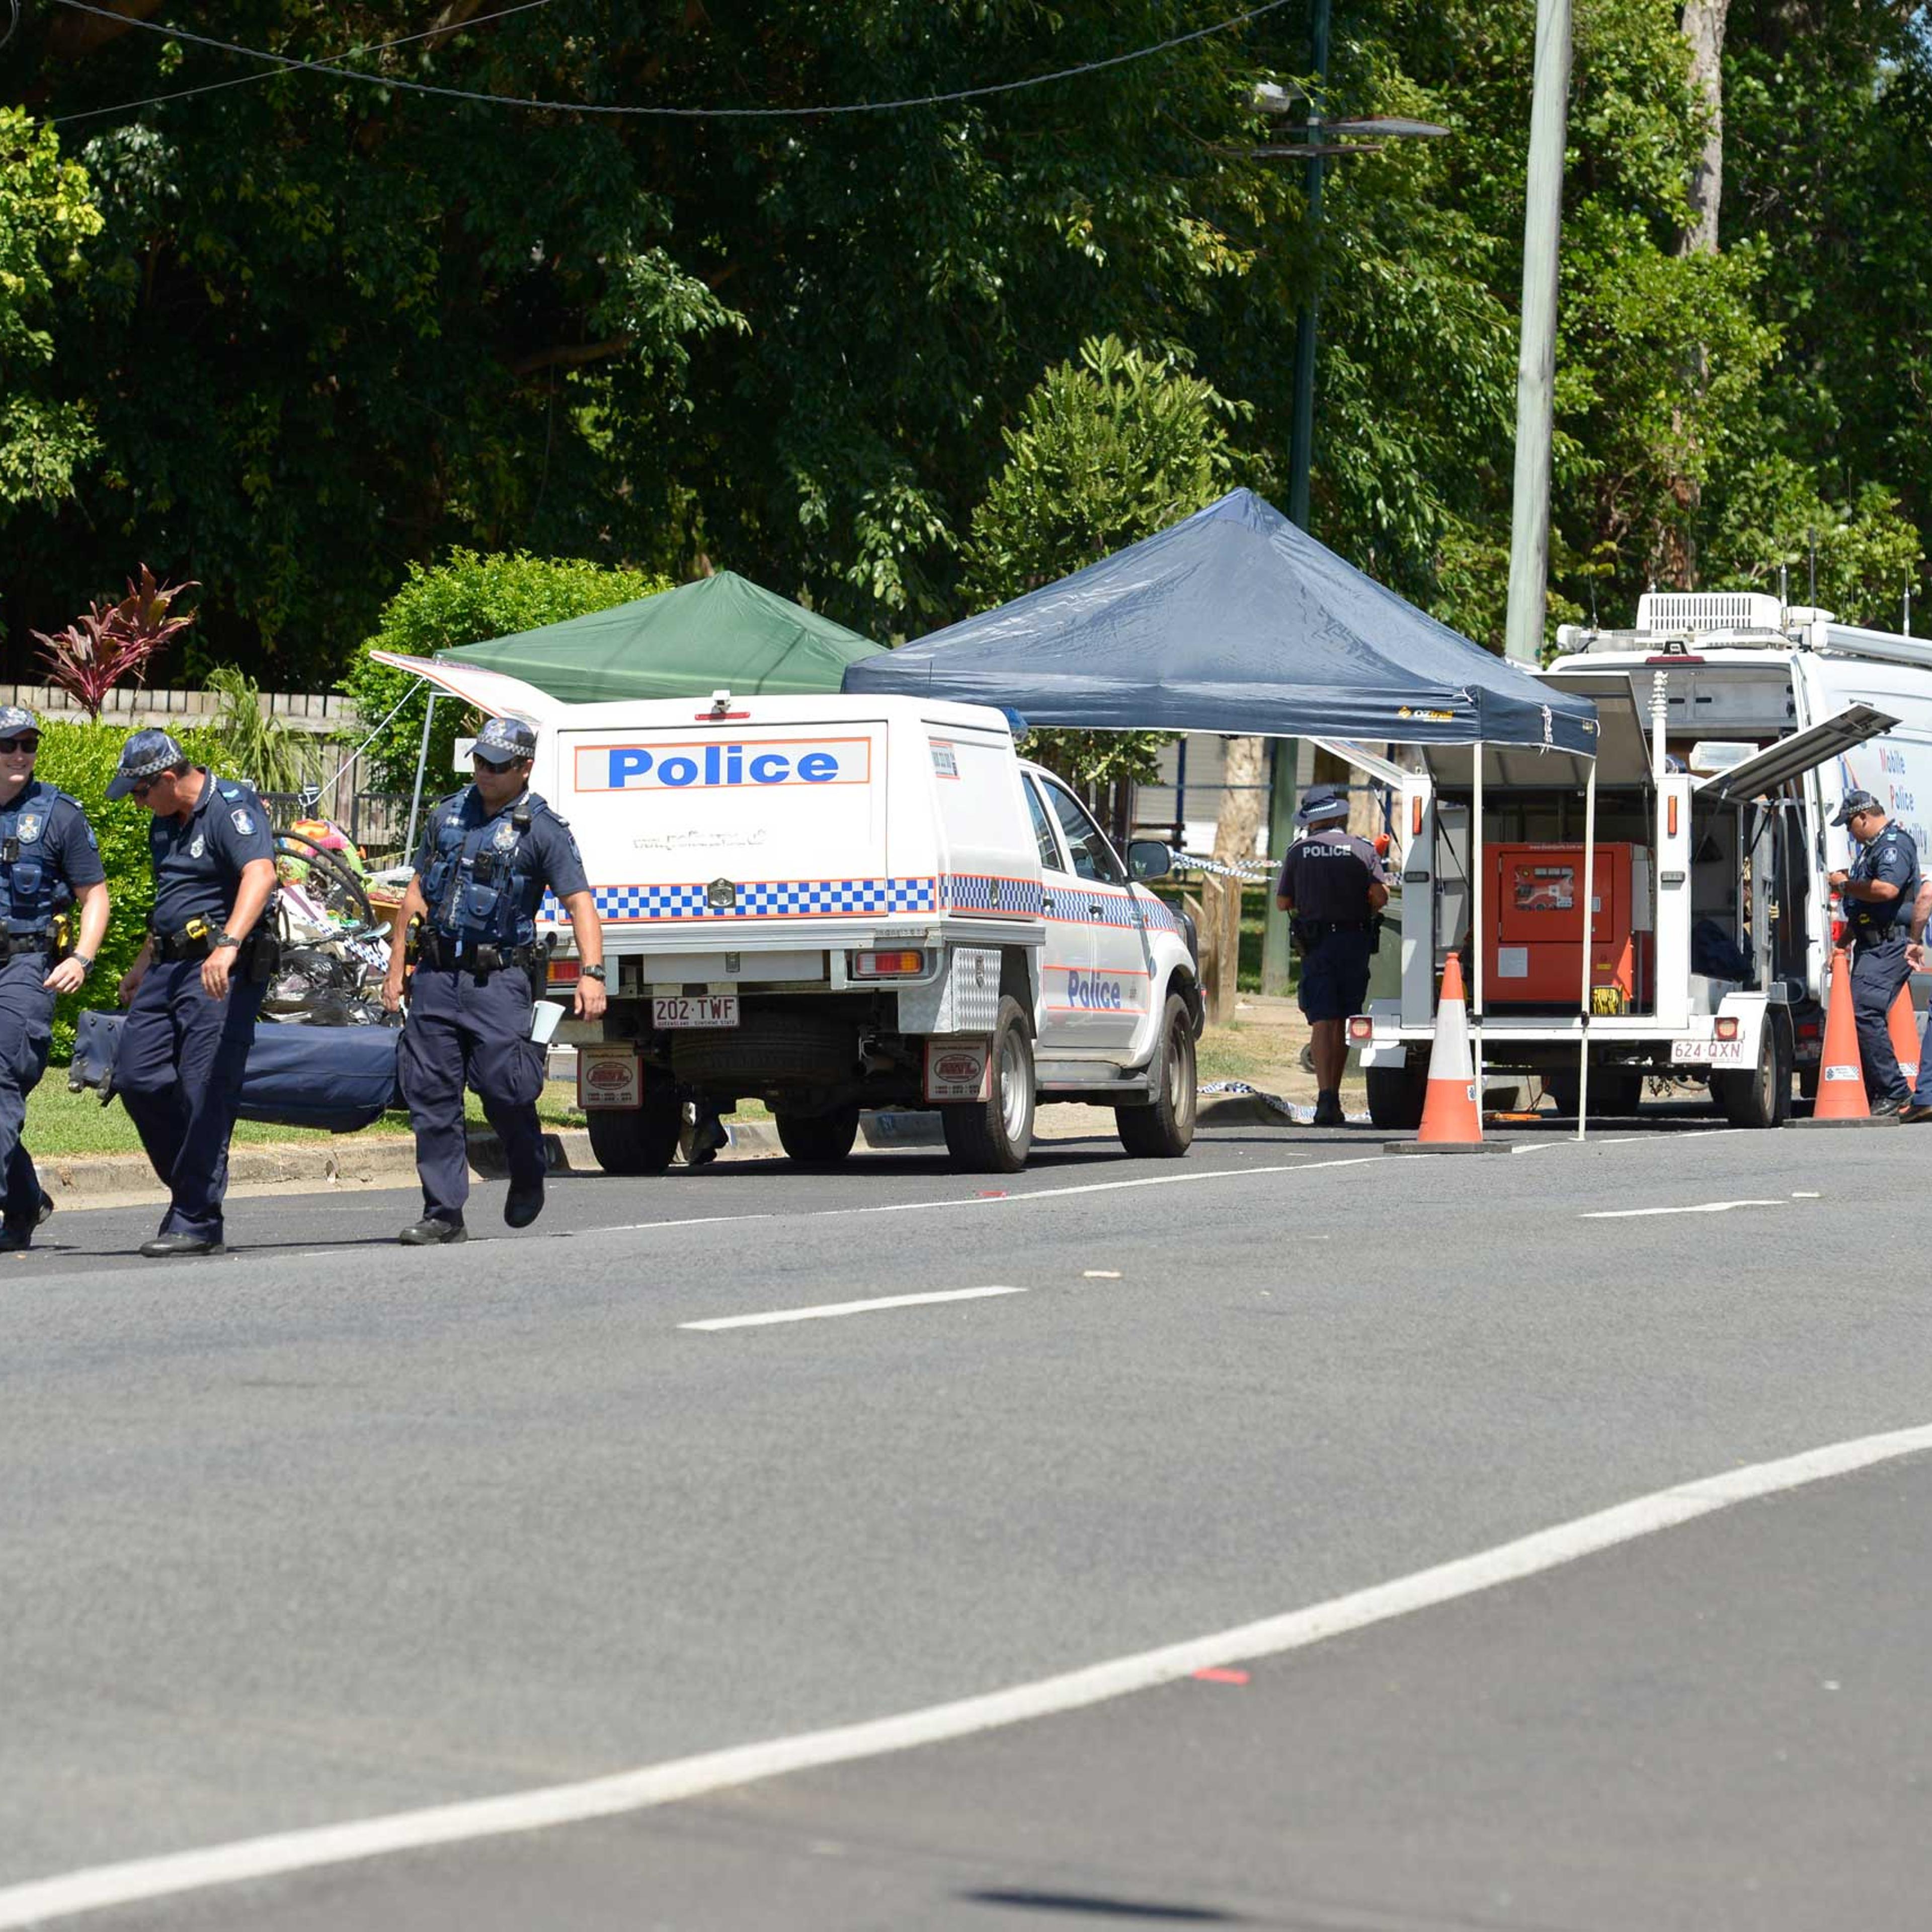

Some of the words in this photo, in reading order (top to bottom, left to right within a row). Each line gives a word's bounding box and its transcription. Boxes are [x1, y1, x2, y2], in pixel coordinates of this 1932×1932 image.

[609, 745, 839, 788] Police
[1879, 747, 1905, 775] Mobile
[1890, 784, 1914, 811] Police
[1303, 845, 1351, 858] POLICE
[1068, 970, 1120, 1009] Police
